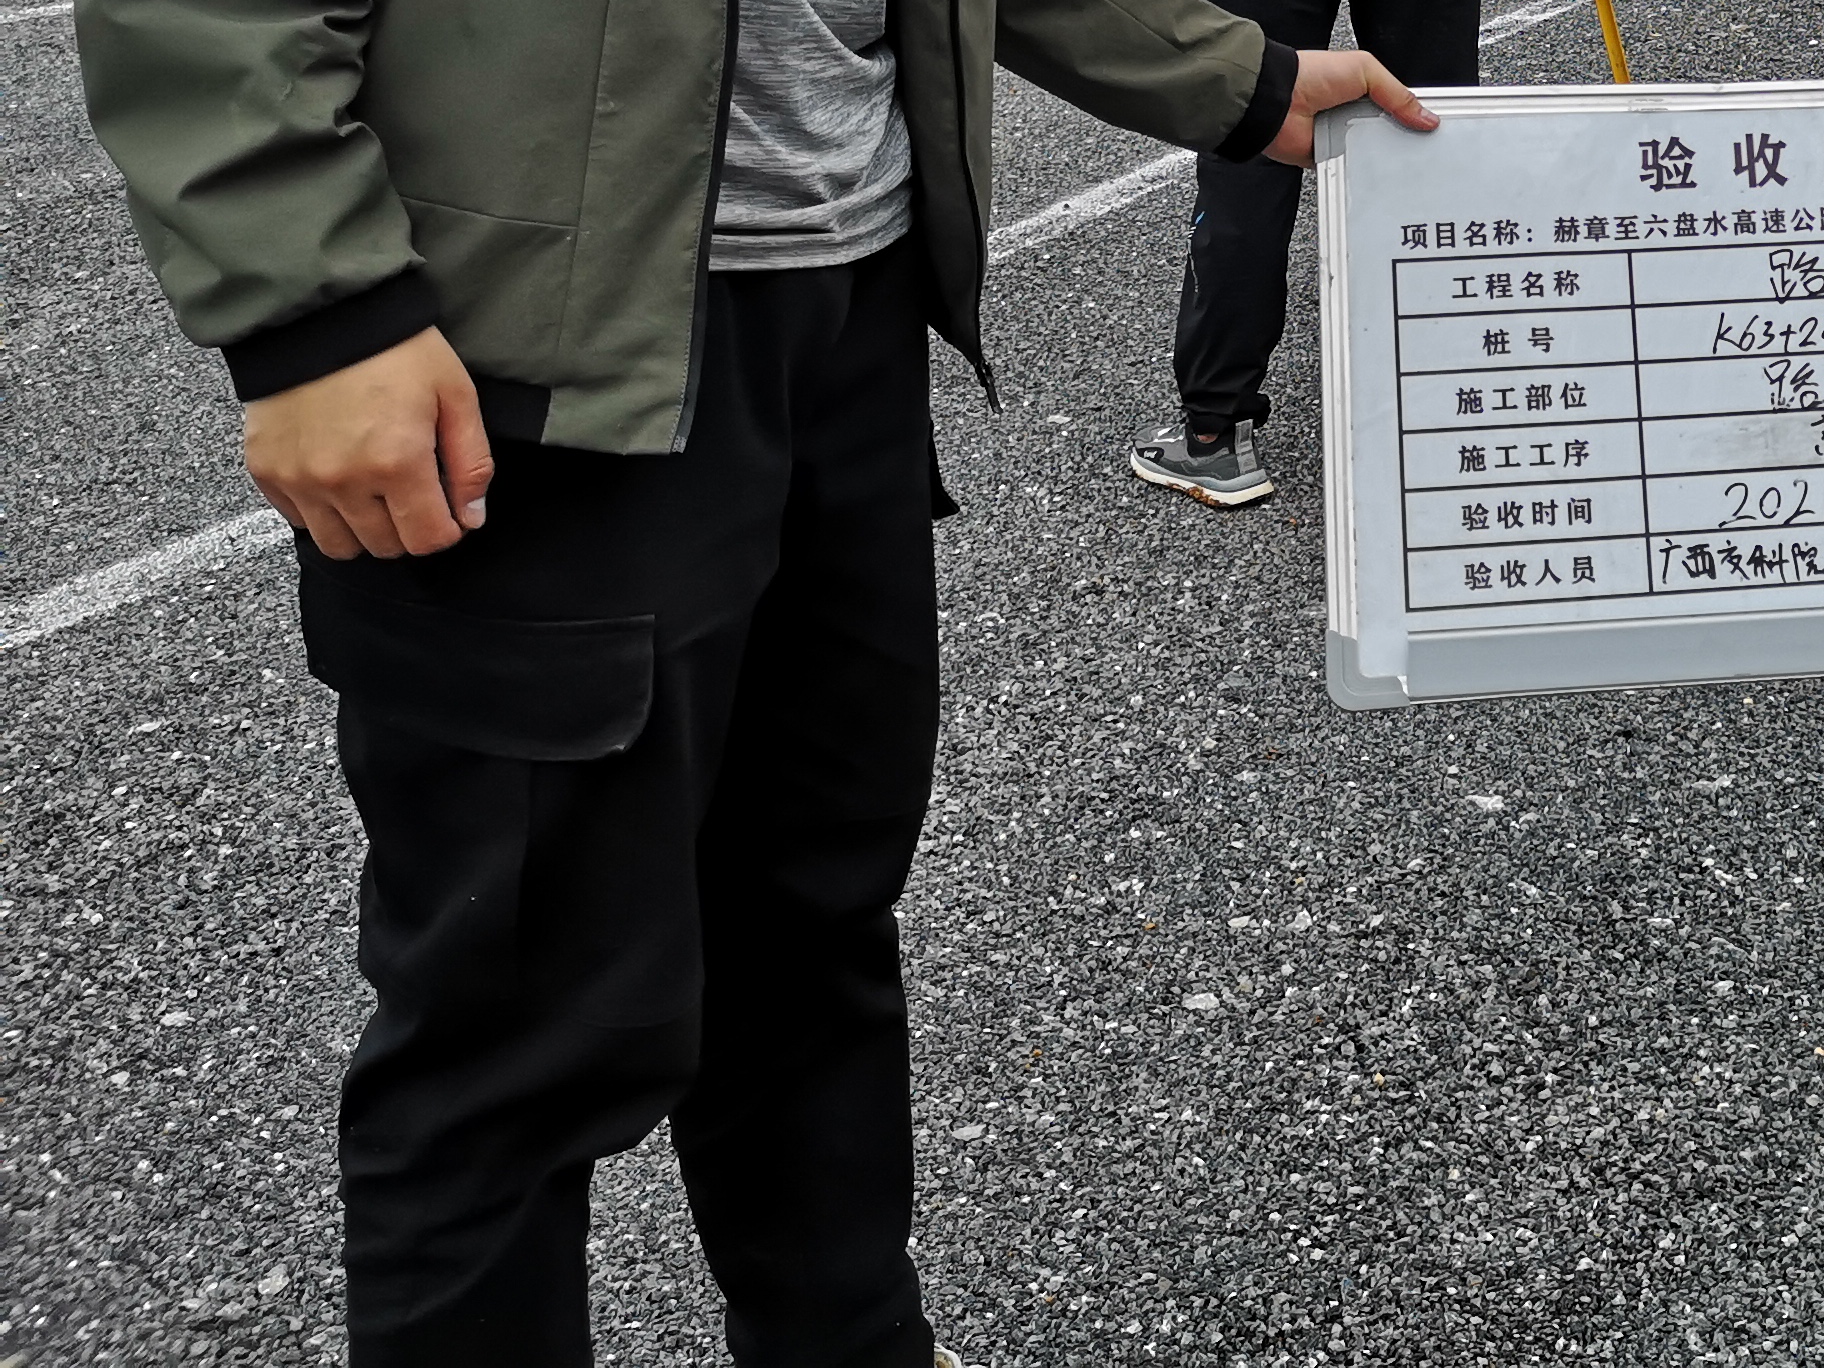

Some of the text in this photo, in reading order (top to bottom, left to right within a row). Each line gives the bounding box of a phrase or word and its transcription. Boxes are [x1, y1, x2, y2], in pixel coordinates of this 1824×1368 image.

[1452, 270, 1581, 300] 工程名称
[1482, 327, 1554, 356] 桩号
[1456, 382, 1587, 415] 施工部位
[1459, 440, 1590, 473] 施工工序
[1462, 498, 1593, 531] 验收时间
[1464, 556, 1596, 590] 验收人员
